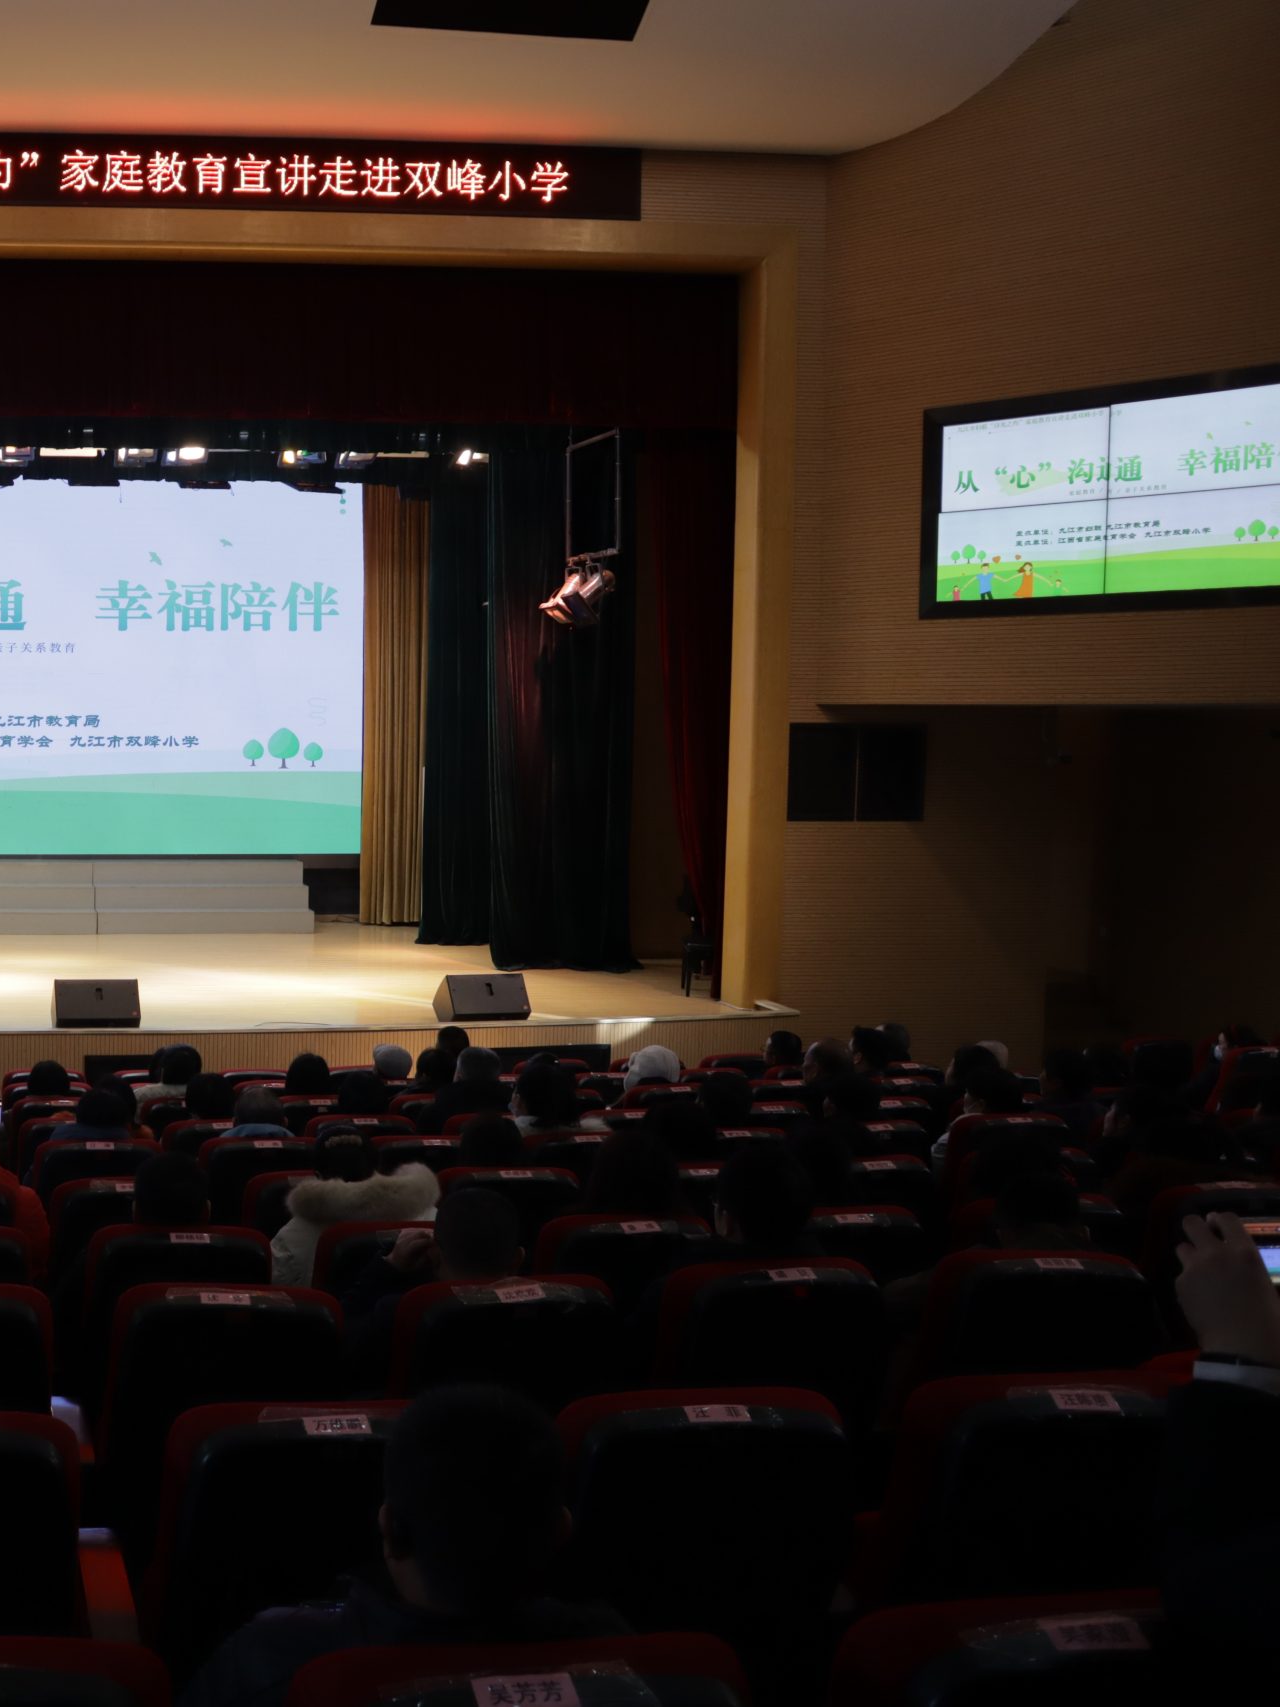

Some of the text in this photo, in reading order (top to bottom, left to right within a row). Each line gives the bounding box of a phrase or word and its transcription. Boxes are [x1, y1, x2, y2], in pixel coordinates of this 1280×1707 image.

[1177, 442, 1280, 476] 幸福陪
[95, 578, 340, 632] 幸福陪伴
[70, 735, 200, 748] 九江市双峰小学
